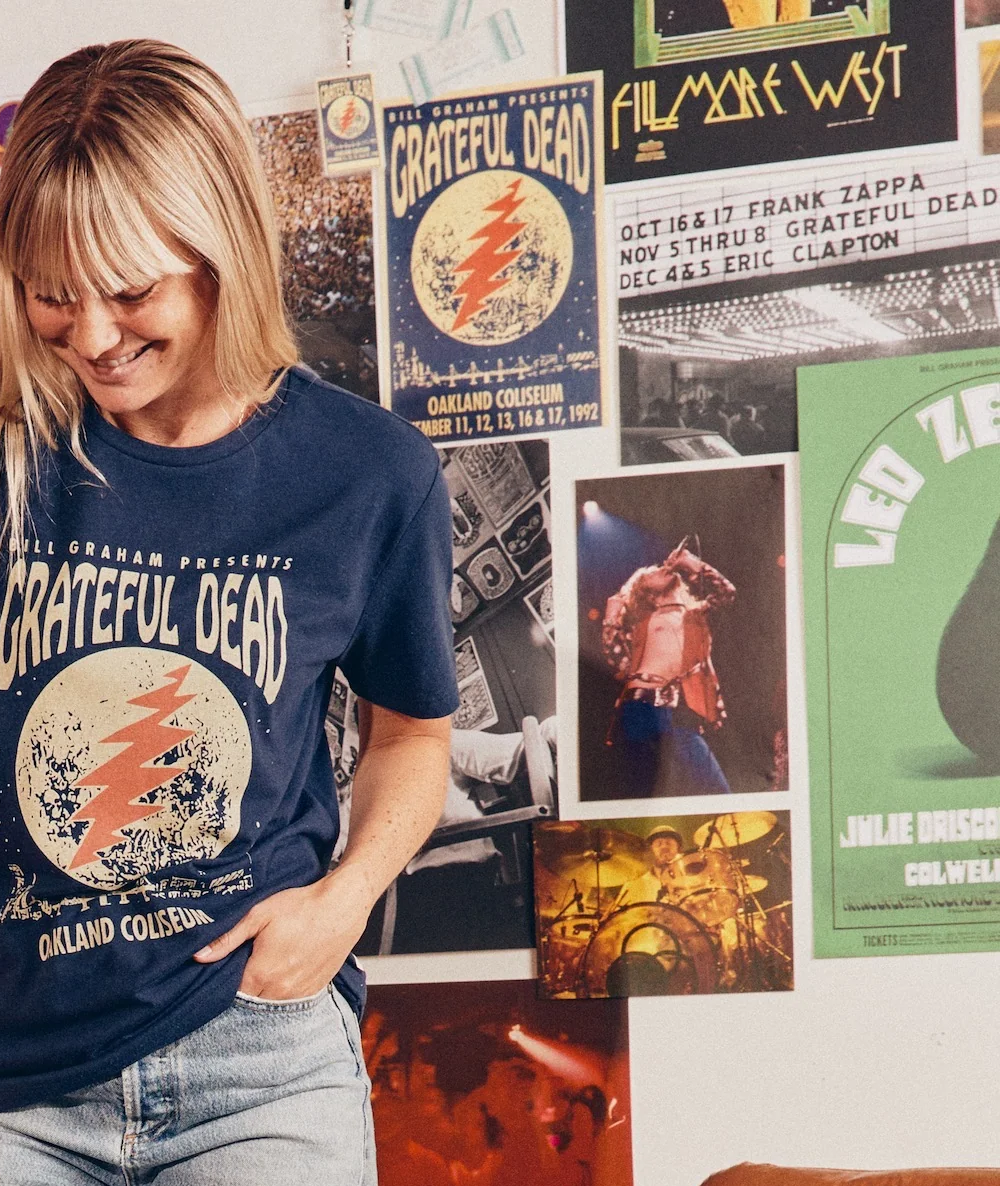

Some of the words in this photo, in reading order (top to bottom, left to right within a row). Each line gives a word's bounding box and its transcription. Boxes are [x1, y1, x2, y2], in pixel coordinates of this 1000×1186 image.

[389, 109, 422, 123] BILL
[432, 98, 499, 117] GRAHAM
[509, 86, 589, 107] PRESENTS
[611, 62, 784, 150] FILLMORE
[791, 40, 908, 116] WEST
[391, 112, 515, 219] GRATEFUL
[524, 102, 590, 195] DEAD
[620, 245, 659, 266] NOV
[670, 240, 680, 258] 5
[686, 229, 746, 254] THRU
[754, 226, 766, 244] 8
[786, 201, 914, 239] GRATEFUL
[928, 187, 998, 215] DEAD
[621, 218, 661, 242] OCT
[714, 206, 733, 225] 17
[749, 189, 825, 220] FRANK
[840, 172, 926, 205] ZAPPA
[620, 269, 657, 290] DEC
[725, 249, 774, 274] ERIC
[792, 229, 900, 263] CLAPTON
[427, 391, 492, 416] OAKLAND
[496, 383, 563, 409] COLISEUM
[455, 416, 473, 435] 11,
[476, 414, 494, 432] 12,
[497, 412, 515, 431] 13,
[518, 410, 533, 427] 16
[534, 410, 545, 426] &
[550, 407, 566, 426] 17,
[569, 404, 599, 422] 1992
[915, 383, 1000, 464] ZE
[834, 444, 925, 568] LED
[69, 540, 163, 567] GRAHAM
[180, 554, 293, 571] PRESENTS
[196, 572, 288, 705] DEAD
[839, 811, 914, 848] JULIE
[917, 807, 1000, 844] DRISCO
[39, 916, 115, 962] OAKLAND
[120, 906, 215, 942] COLISEUM
[863, 934, 898, 947] TICKETS
